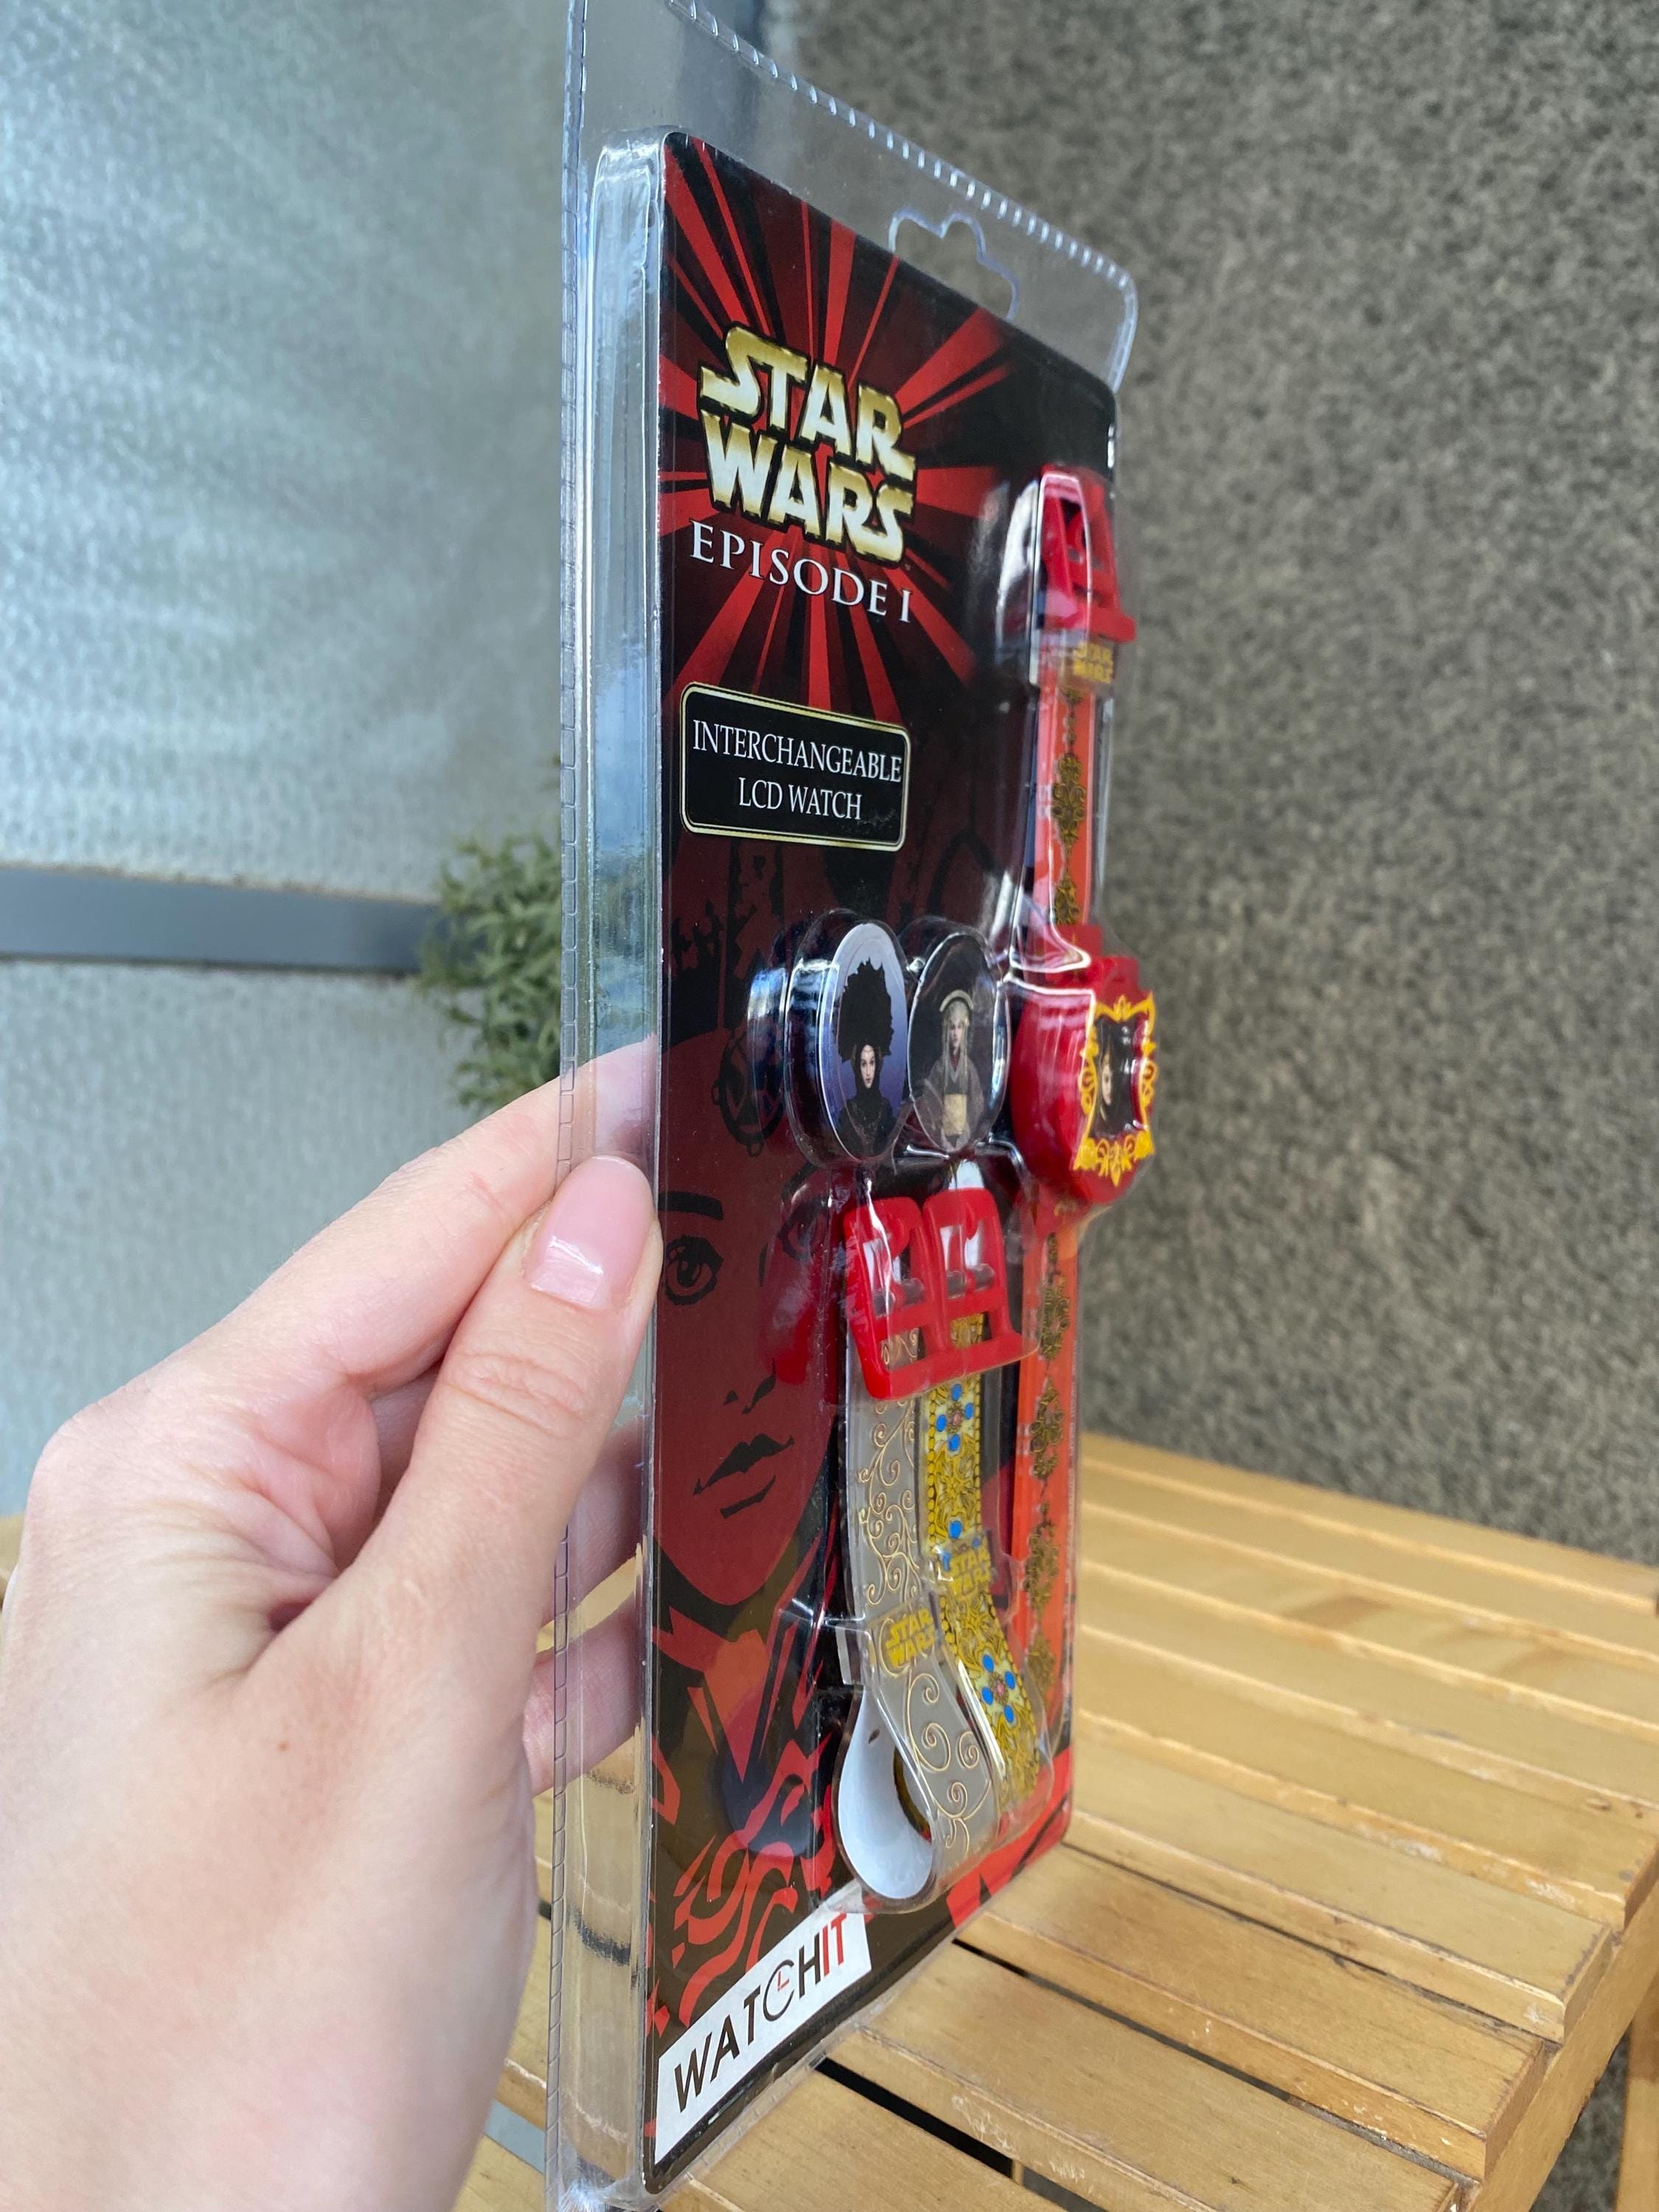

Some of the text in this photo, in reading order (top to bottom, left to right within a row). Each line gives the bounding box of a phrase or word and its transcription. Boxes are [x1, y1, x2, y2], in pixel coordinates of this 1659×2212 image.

[700, 324, 917, 481] STAR
[700, 409, 915, 563] WARS
[689, 520, 913, 624] EPISODE I
[692, 719, 902, 783] INTERCHANGEABLE
[738, 776, 863, 821] LCD WATCH
[886, 1608, 933, 1649] STAR
[888, 1625, 935, 1669] WARS
[674, 1912, 848, 2113] WATCHIT
